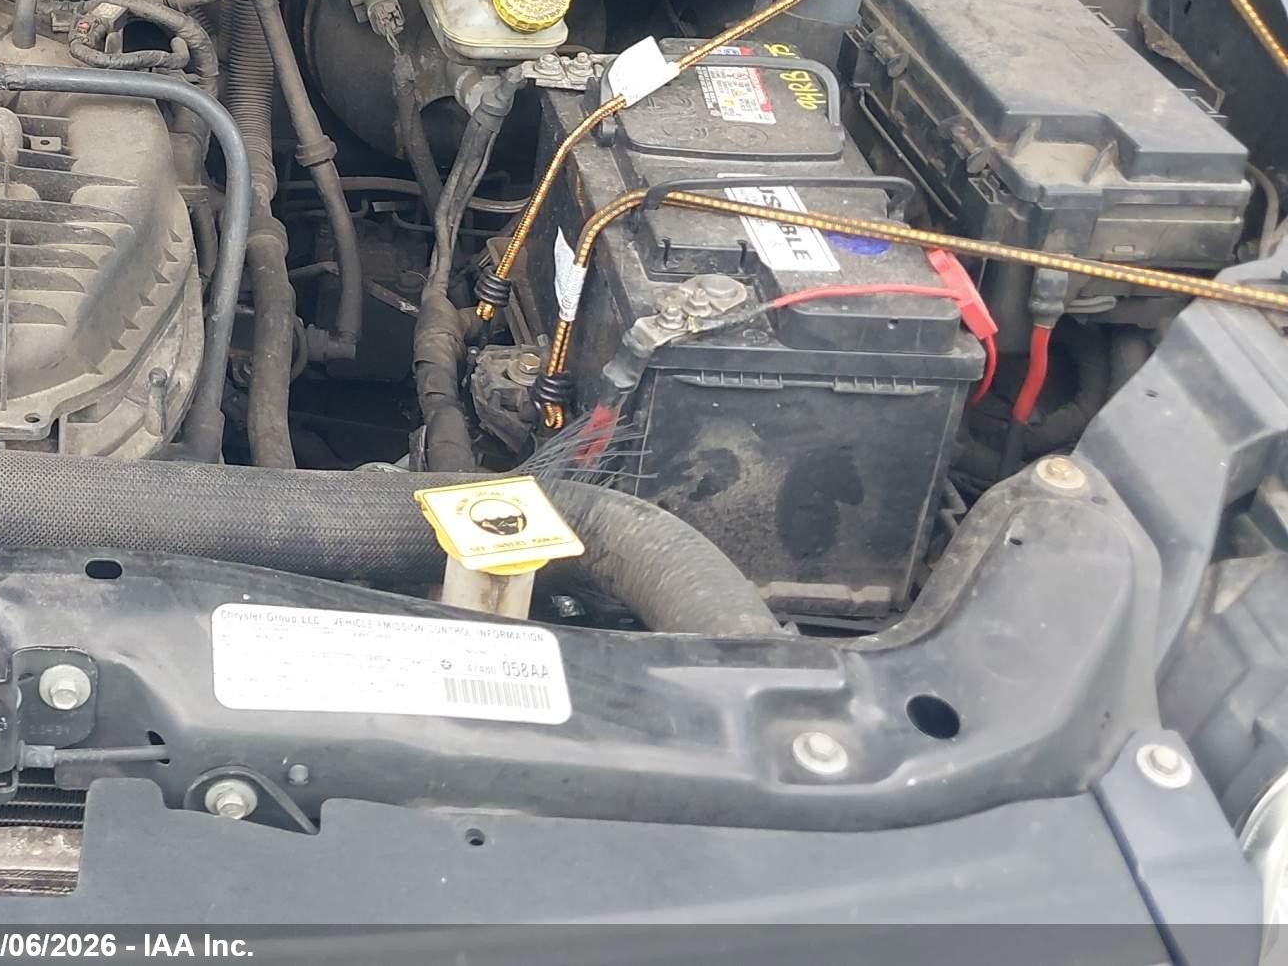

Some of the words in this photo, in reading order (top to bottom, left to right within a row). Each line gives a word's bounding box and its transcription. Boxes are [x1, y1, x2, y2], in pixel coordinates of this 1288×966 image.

[220, 609, 263, 623] Chrysler
[266, 612, 298, 624] Group
[301, 615, 321, 625] LLC
[333, 618, 373, 629] VEHICLE
[428, 624, 472, 638] CONTROL
[478, 629, 545, 643] INFORMATION
[502, 660, 550, 679] 058AA
